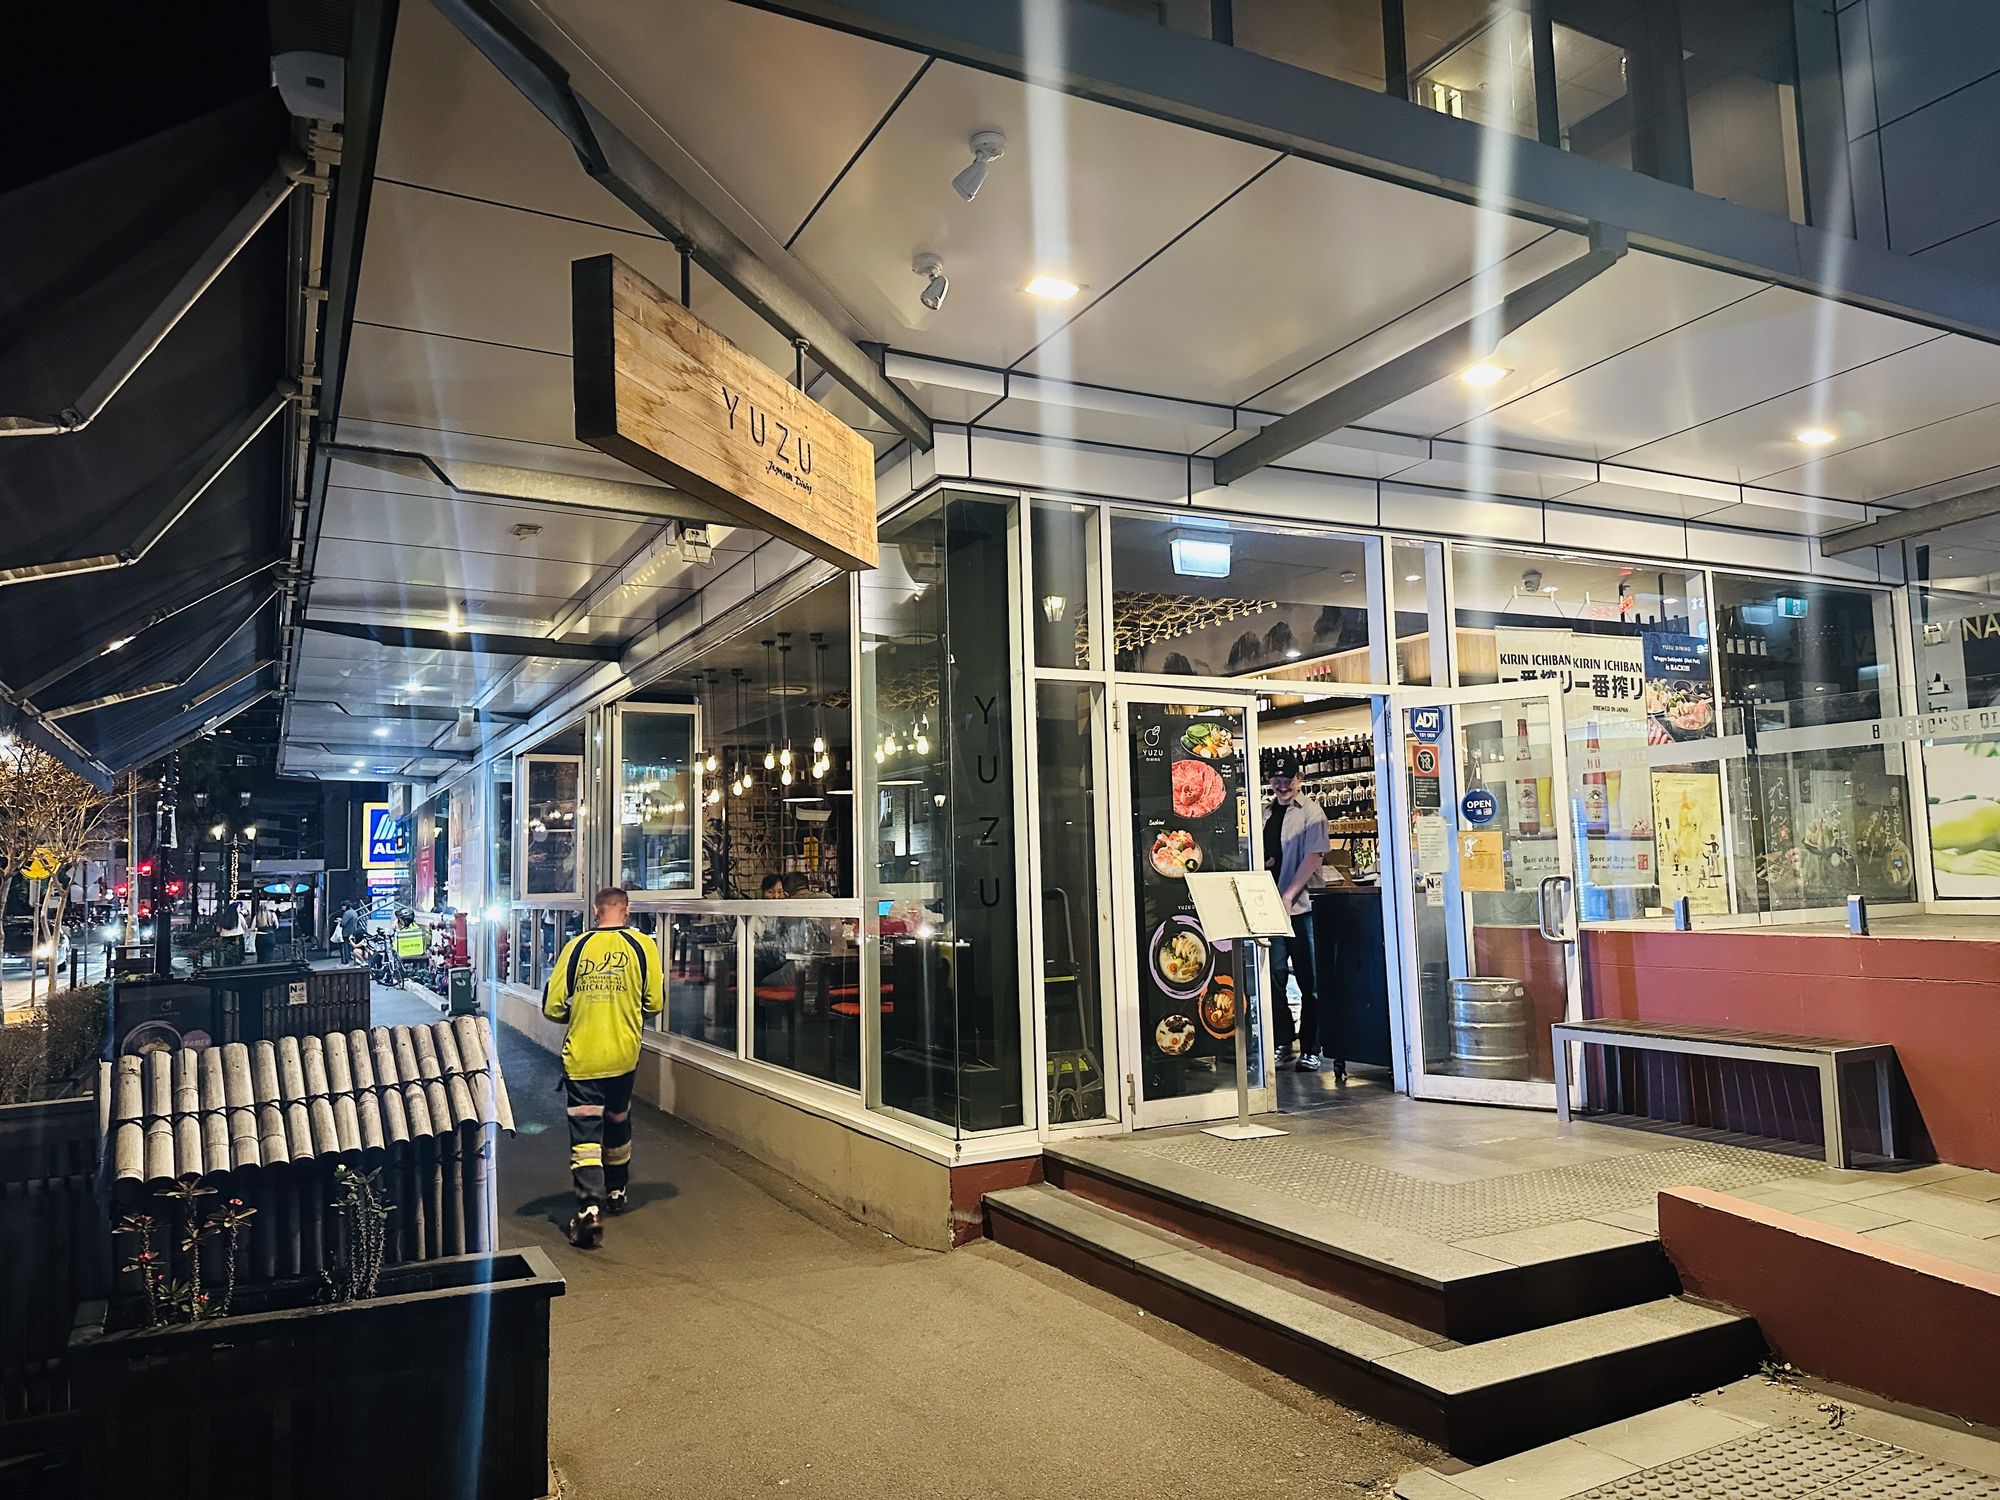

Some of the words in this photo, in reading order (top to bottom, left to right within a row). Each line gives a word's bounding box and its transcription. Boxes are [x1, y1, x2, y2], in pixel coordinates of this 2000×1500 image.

[722, 386, 811, 475] YUZU
[1500, 653, 1529, 665] KIRIN
[1532, 654, 1571, 666] ICHIBAN
[1573, 657, 1600, 669] KIRIN
[1604, 661, 1642, 673] ICHIBAN
[1575, 674, 1643, 700] 一番搾り
[1415, 712, 1438, 728] ADT
[974, 695, 1000, 908] YUZU
[1467, 800, 1491, 808] OPEN
[1589, 854, 1604, 862] Beer
